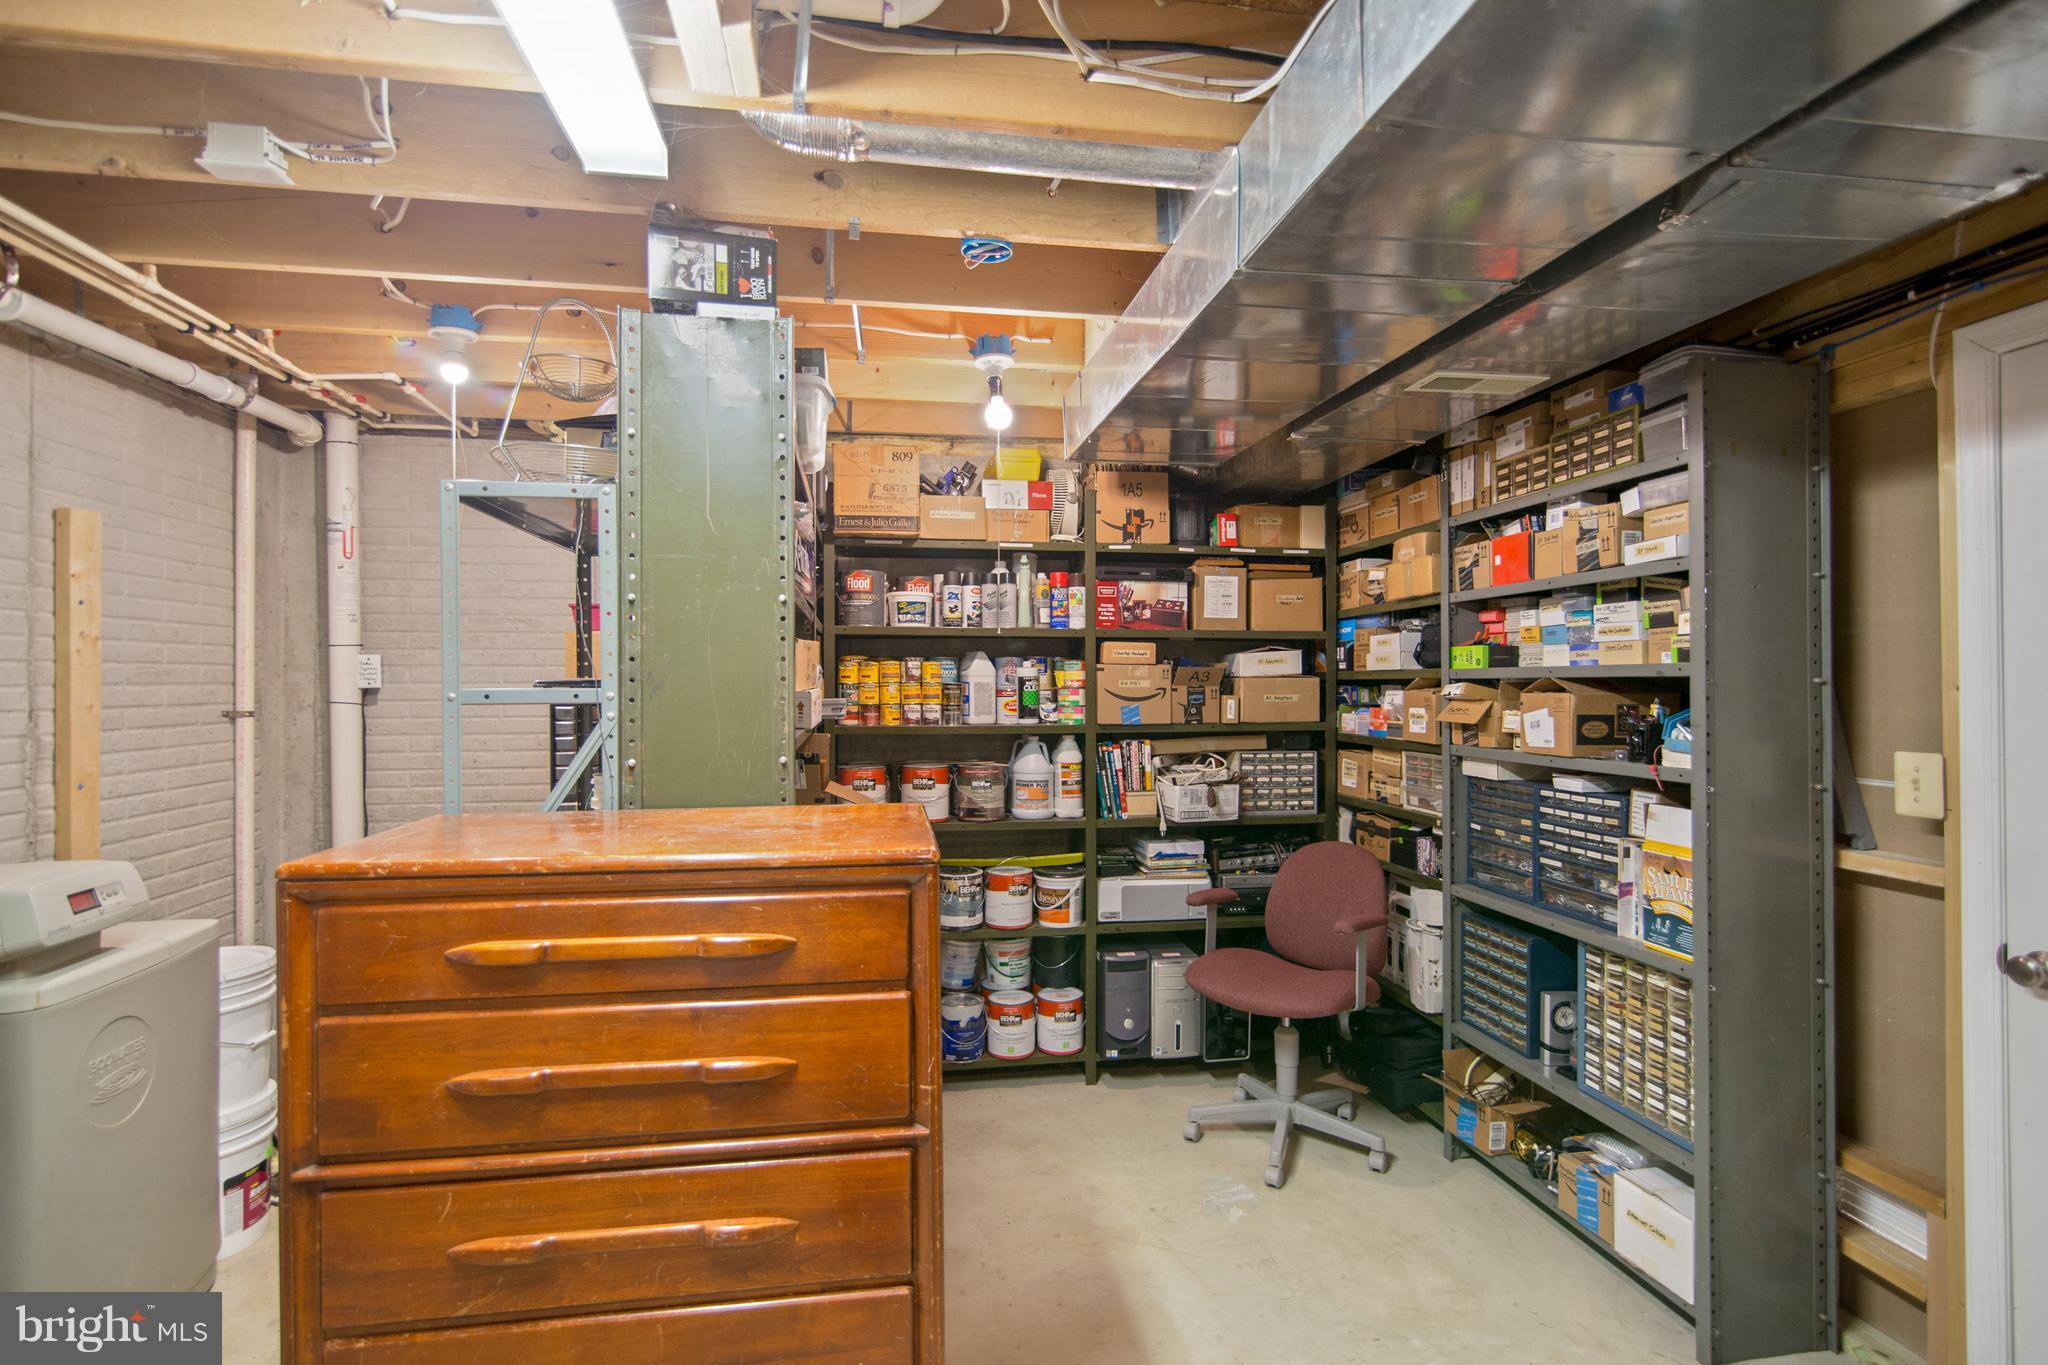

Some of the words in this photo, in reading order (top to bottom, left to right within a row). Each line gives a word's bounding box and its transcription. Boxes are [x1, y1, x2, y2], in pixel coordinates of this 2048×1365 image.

[891, 451, 914, 462] 809
[1121, 480, 1144, 498] 1A5
[839, 516, 863, 526] Ernest
[871, 517, 888, 528] Julio
[888, 517, 911, 527] Gallo
[847, 578, 870, 589] Flood
[907, 583, 930, 593] Flood
[947, 591, 960, 600] 2X
[1188, 671, 1211, 683] A3
[1647, 866, 1693, 892] SAMUE
[960, 886, 976, 894] BEHR
[88, 1035, 146, 1073] ECOWATER
